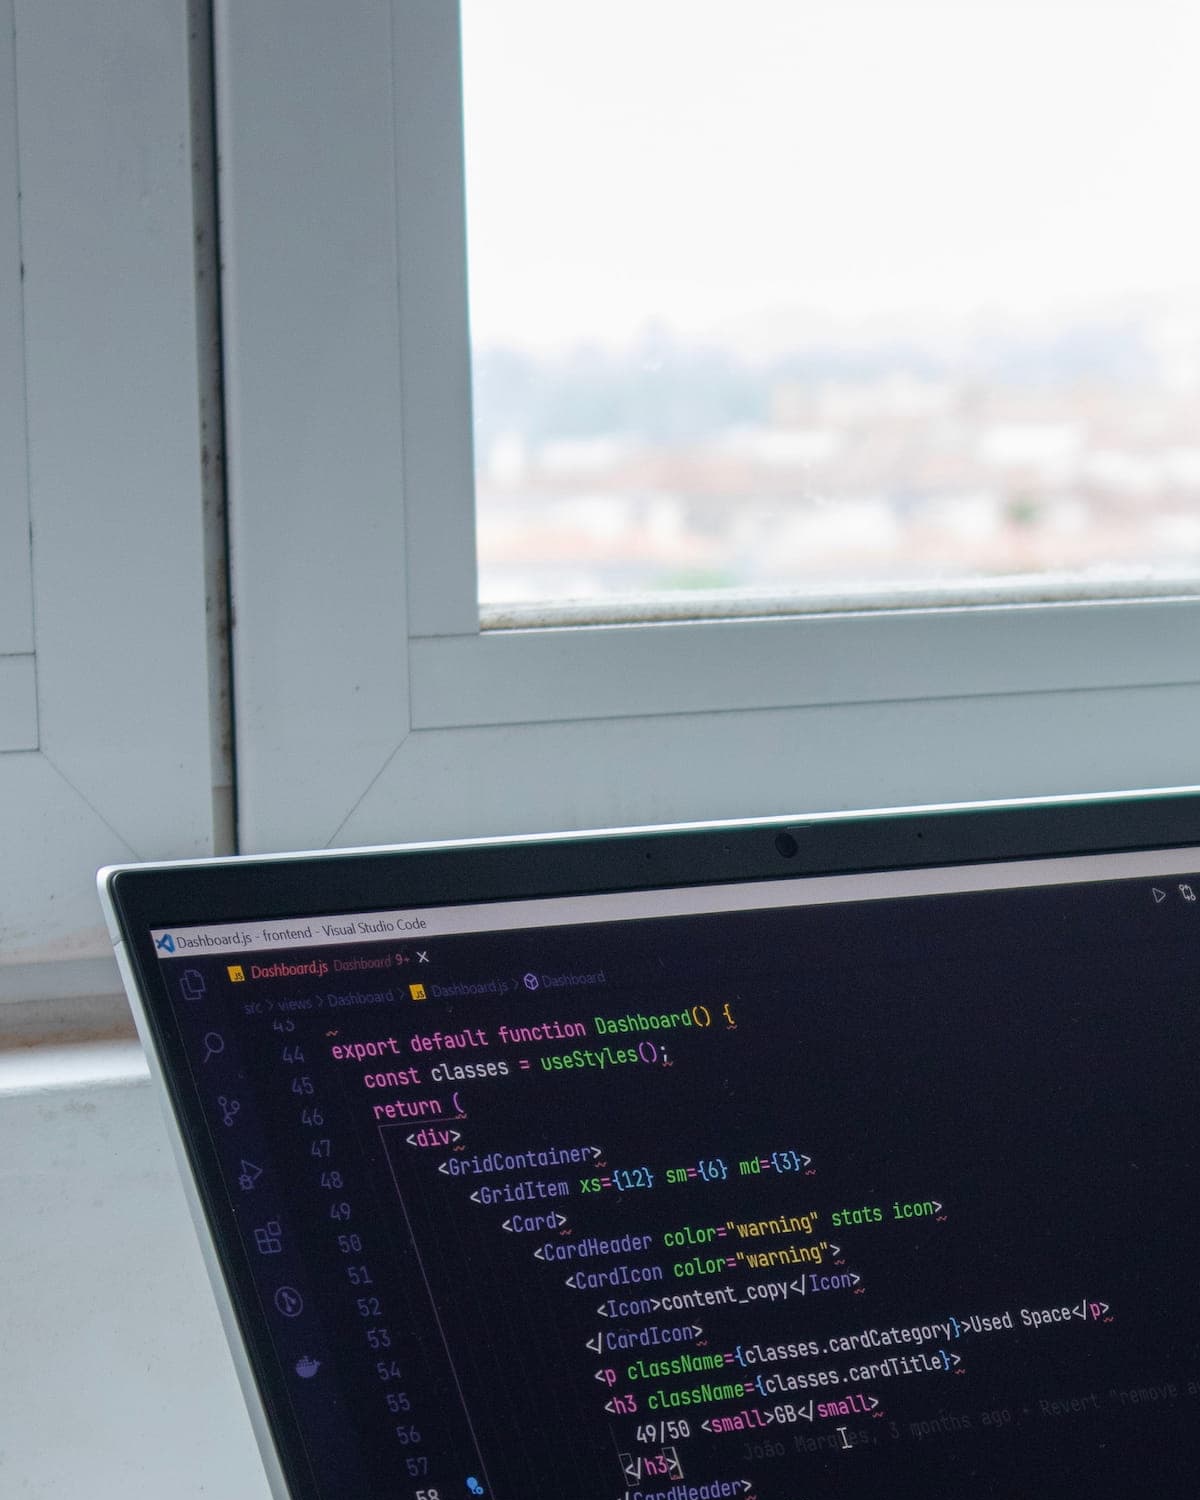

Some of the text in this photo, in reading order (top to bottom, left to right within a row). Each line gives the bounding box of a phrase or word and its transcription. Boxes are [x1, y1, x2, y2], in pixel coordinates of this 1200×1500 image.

[176, 931, 252, 949] Dashboard.js
[263, 926, 312, 942] frontend
[322, 924, 356, 938] Visual
[358, 921, 394, 934] Studio
[397, 918, 427, 931] Code
[251, 961, 329, 979] Dashboard.js
[334, 956, 392, 972] Dashboard
[432, 978, 509, 998] Dashboard.js
[542, 971, 605, 988] Dashboard
[279, 998, 313, 1011] views
[328, 990, 394, 1008] Dashboard
[331, 1038, 400, 1061] export
[410, 1028, 488, 1053] default
[499, 1020, 586, 1044] function
[594, 1005, 711, 1035] Dashboard()
[282, 1045, 304, 1063] 44
[364, 1067, 421, 1089] const
[431, 1060, 509, 1082] classes
[540, 1041, 668, 1072] useStyles();
[292, 1077, 314, 1094] 45
[302, 1109, 324, 1126] 46
[373, 1098, 442, 1120] return
[405, 1128, 461, 1147] <div>
[311, 1140, 331, 1157] 47
[438, 1146, 602, 1176] <GridContainer>
[321, 1171, 343, 1188] 48
[469, 1150, 811, 1205] <GridItem xs={12} sm={6} md={3}>
[330, 1203, 352, 1220] 49
[502, 1211, 566, 1233] <Card>
[534, 1200, 942, 1261] <CardHeader color="warning" stats icon>
[338, 1233, 362, 1253] 50
[348, 1266, 372, 1285] 51
[565, 1242, 840, 1290] <CardIcon color="warning">
[597, 1273, 860, 1318] <Icon>content_copy</Icon>
[357, 1297, 383, 1317] 52
[367, 1329, 391, 1349] 53
[585, 1325, 702, 1354] </CardIcon>
[594, 1367, 616, 1387] <p
[1020, 1299, 1109, 1329] Space</p>
[376, 1361, 401, 1381] 54
[604, 1350, 961, 1415] <h3 className={classes.cardTitle}>
[386, 1392, 411, 1413] 55
[636, 1395, 879, 1443] 49/50 <small>GB</small>
[909, 1413, 971, 1438] months
[981, 1407, 1011, 1428] ago
[1039, 1394, 1101, 1416] Revert
[396, 1424, 421, 1444] 56
[406, 1456, 428, 1477] 57
